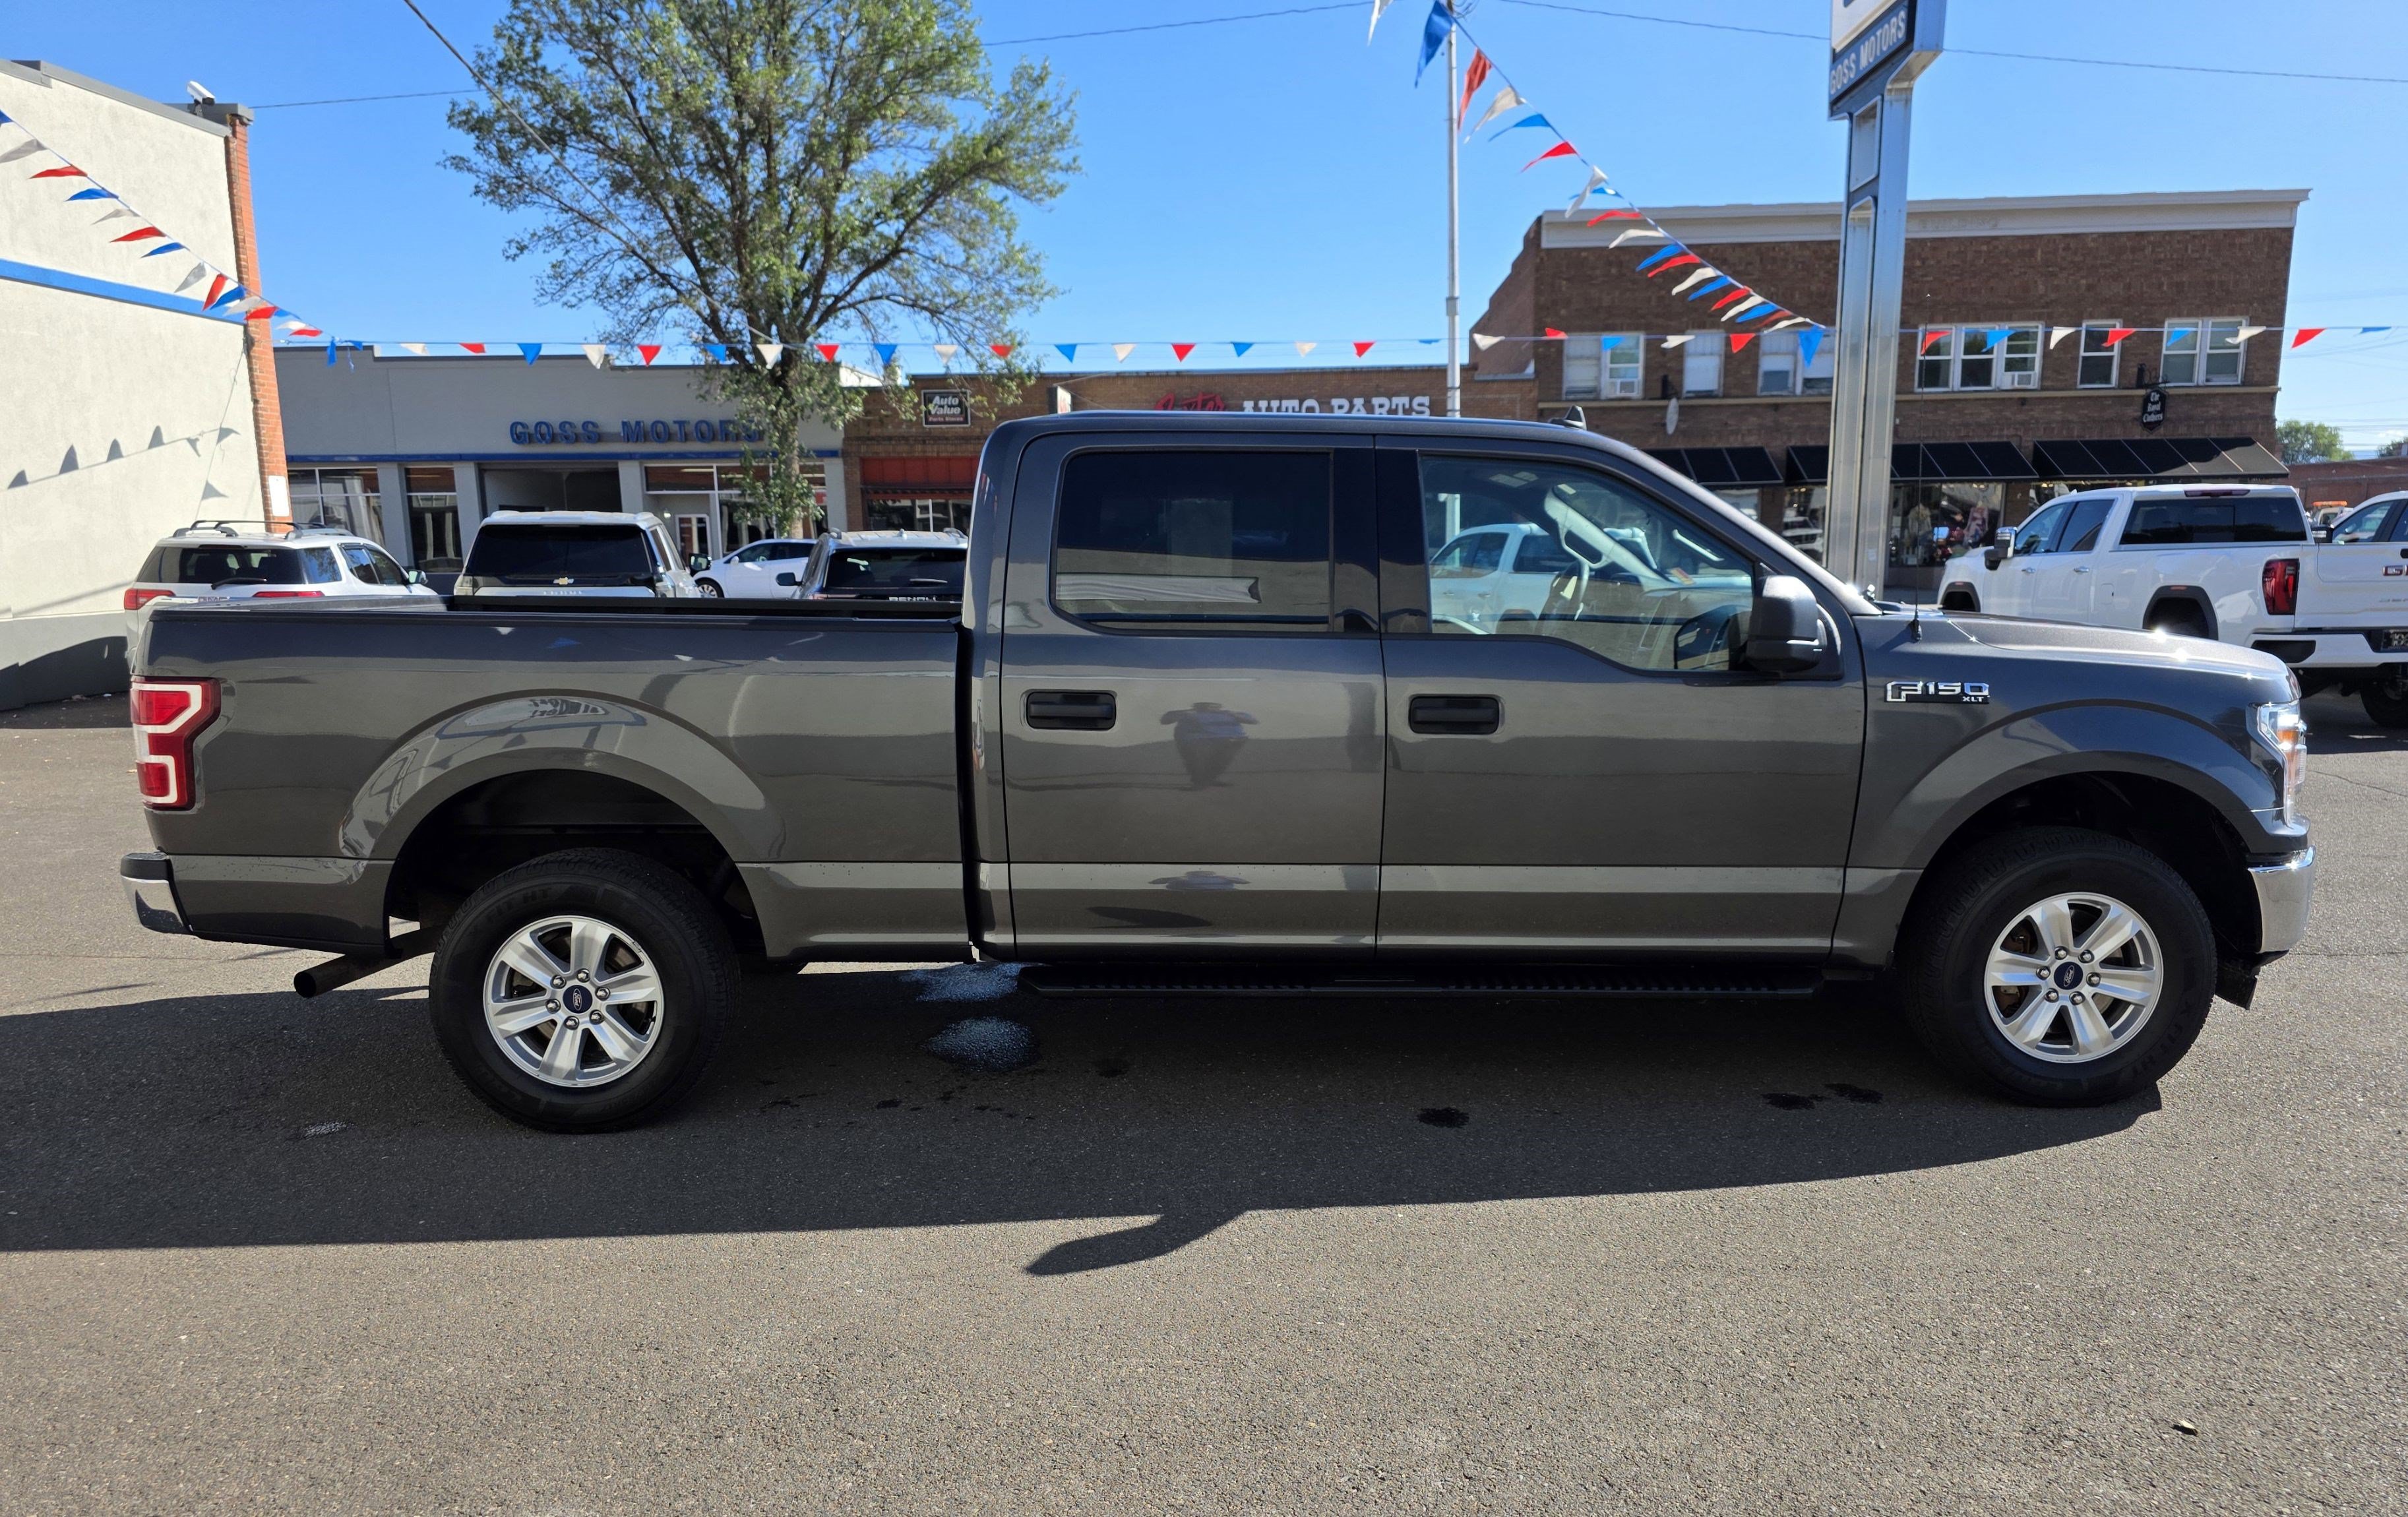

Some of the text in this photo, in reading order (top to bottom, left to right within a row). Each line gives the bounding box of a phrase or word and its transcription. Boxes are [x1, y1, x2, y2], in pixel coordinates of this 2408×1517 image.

[1830, 11, 1906, 94] GOSS MOTORS
[930, 405, 961, 414] Value
[933, 395, 959, 406] Auto
[1331, 396, 1430, 416] PARTS
[510, 421, 600, 445] GOSS
